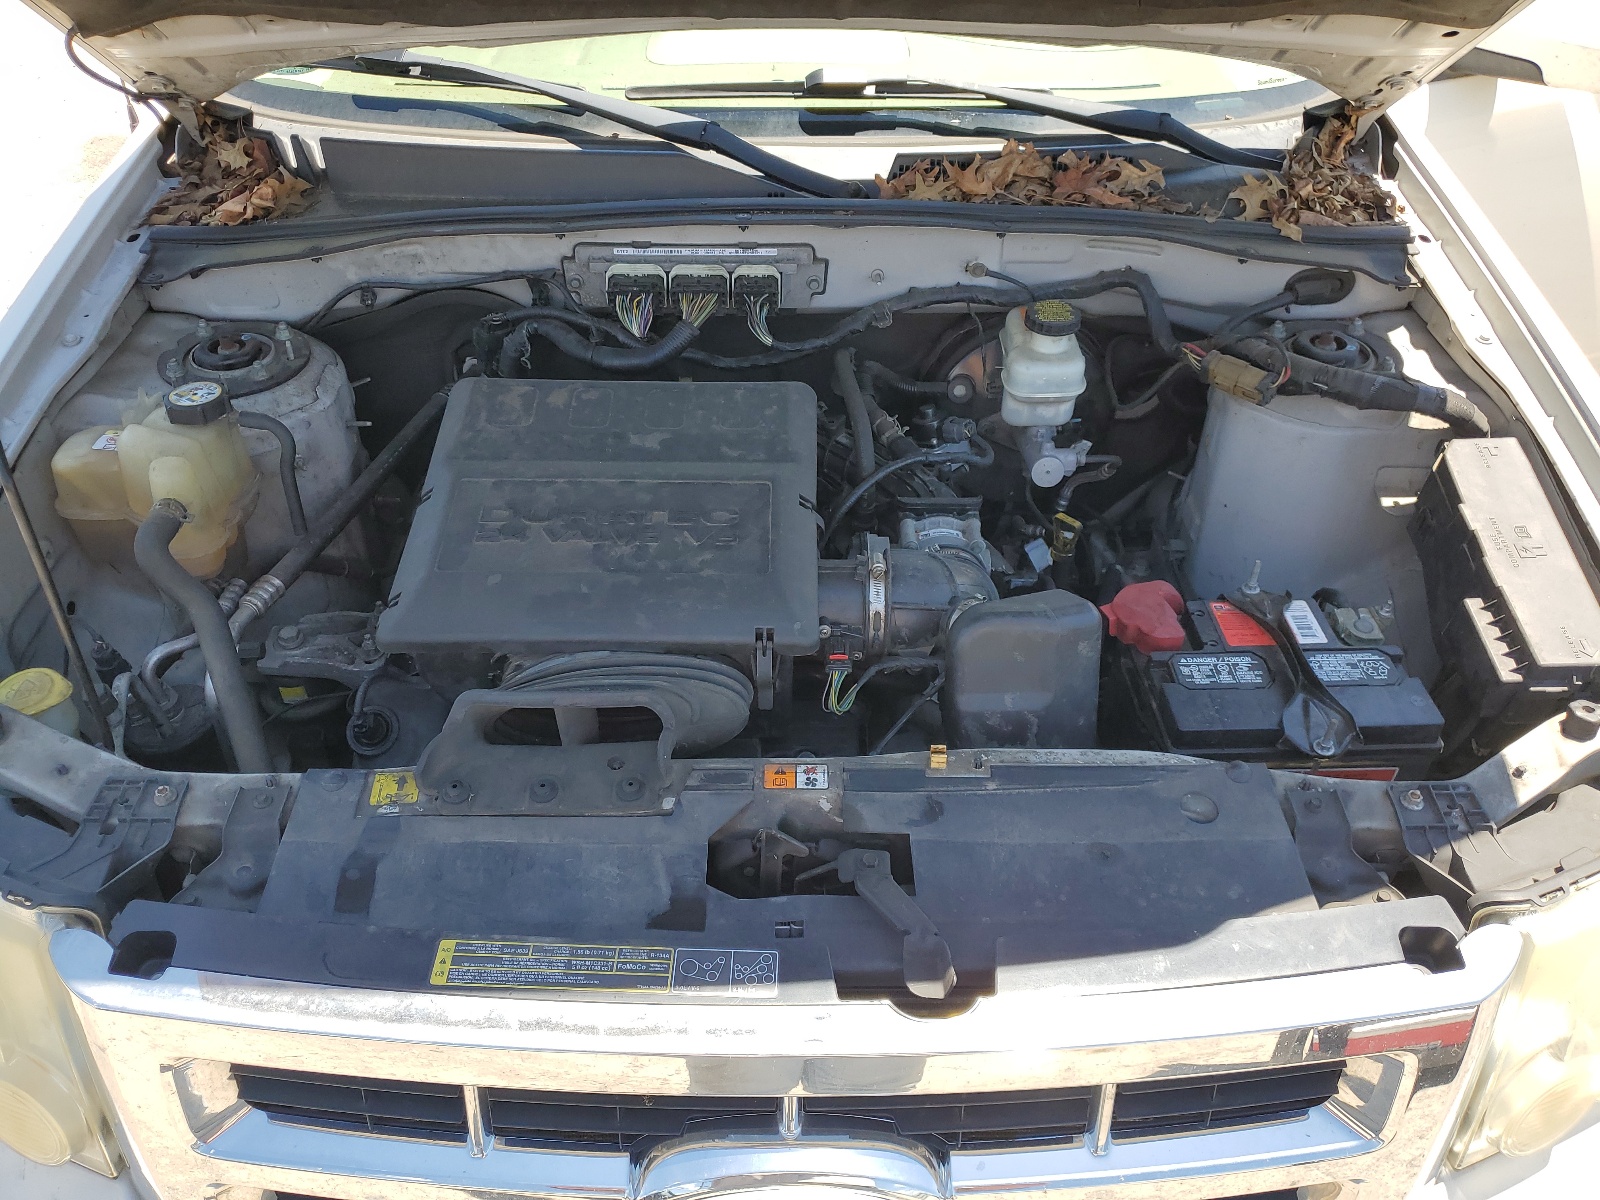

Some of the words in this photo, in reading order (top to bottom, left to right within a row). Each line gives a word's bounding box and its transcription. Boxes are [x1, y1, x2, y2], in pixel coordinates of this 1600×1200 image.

[1488, 516, 1520, 568] COMPARTMENT
[1489, 533, 1503, 551] FUSE
[1560, 626, 1581, 659] RELEASE
